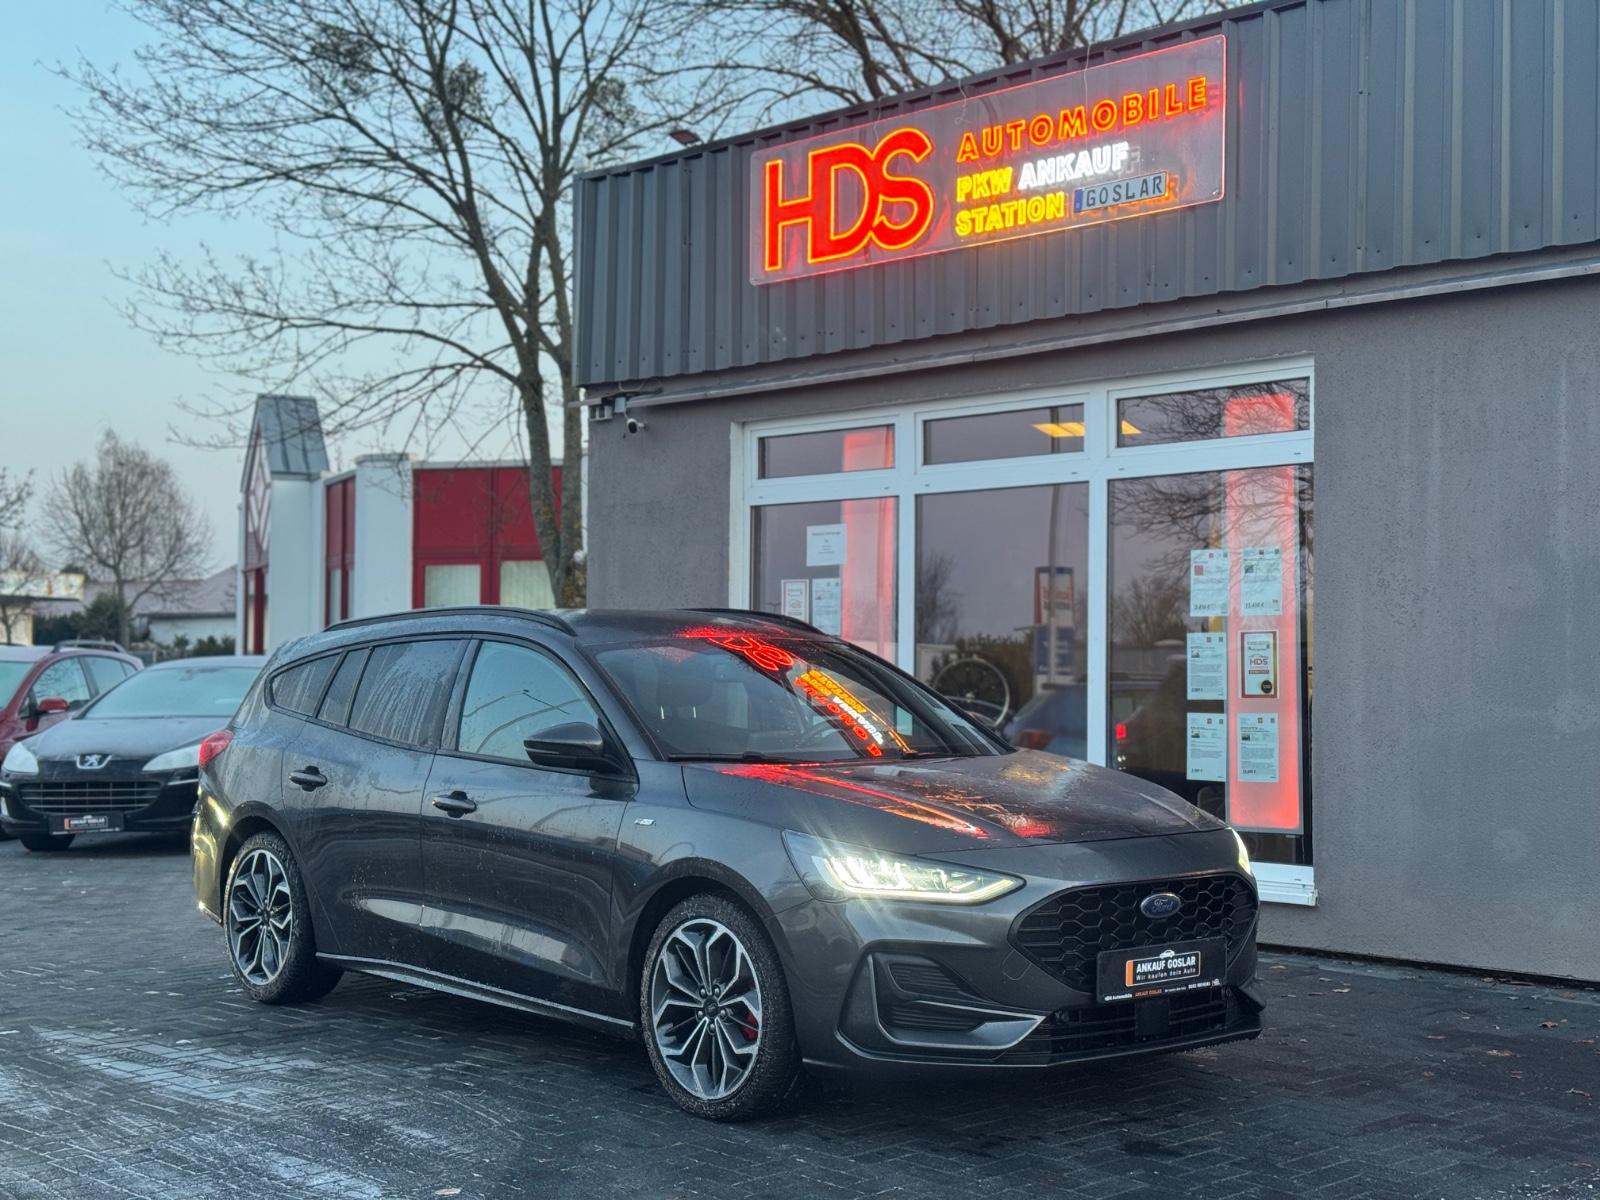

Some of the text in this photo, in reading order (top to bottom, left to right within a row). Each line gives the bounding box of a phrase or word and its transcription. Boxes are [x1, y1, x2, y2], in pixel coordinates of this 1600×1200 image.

[956, 76, 1208, 163] AUTOMOBILE
[764, 127, 934, 272] HDS
[956, 141, 1130, 203] PKW ANKAUF
[954, 175, 1163, 237] STATION GOSLAR
[1152, 899, 1174, 912] Ford
[1136, 956, 1196, 974] ANKAUF GOSLAR
[1136, 973, 1146, 981] Wir
[1183, 967, 1196, 975] Auto
